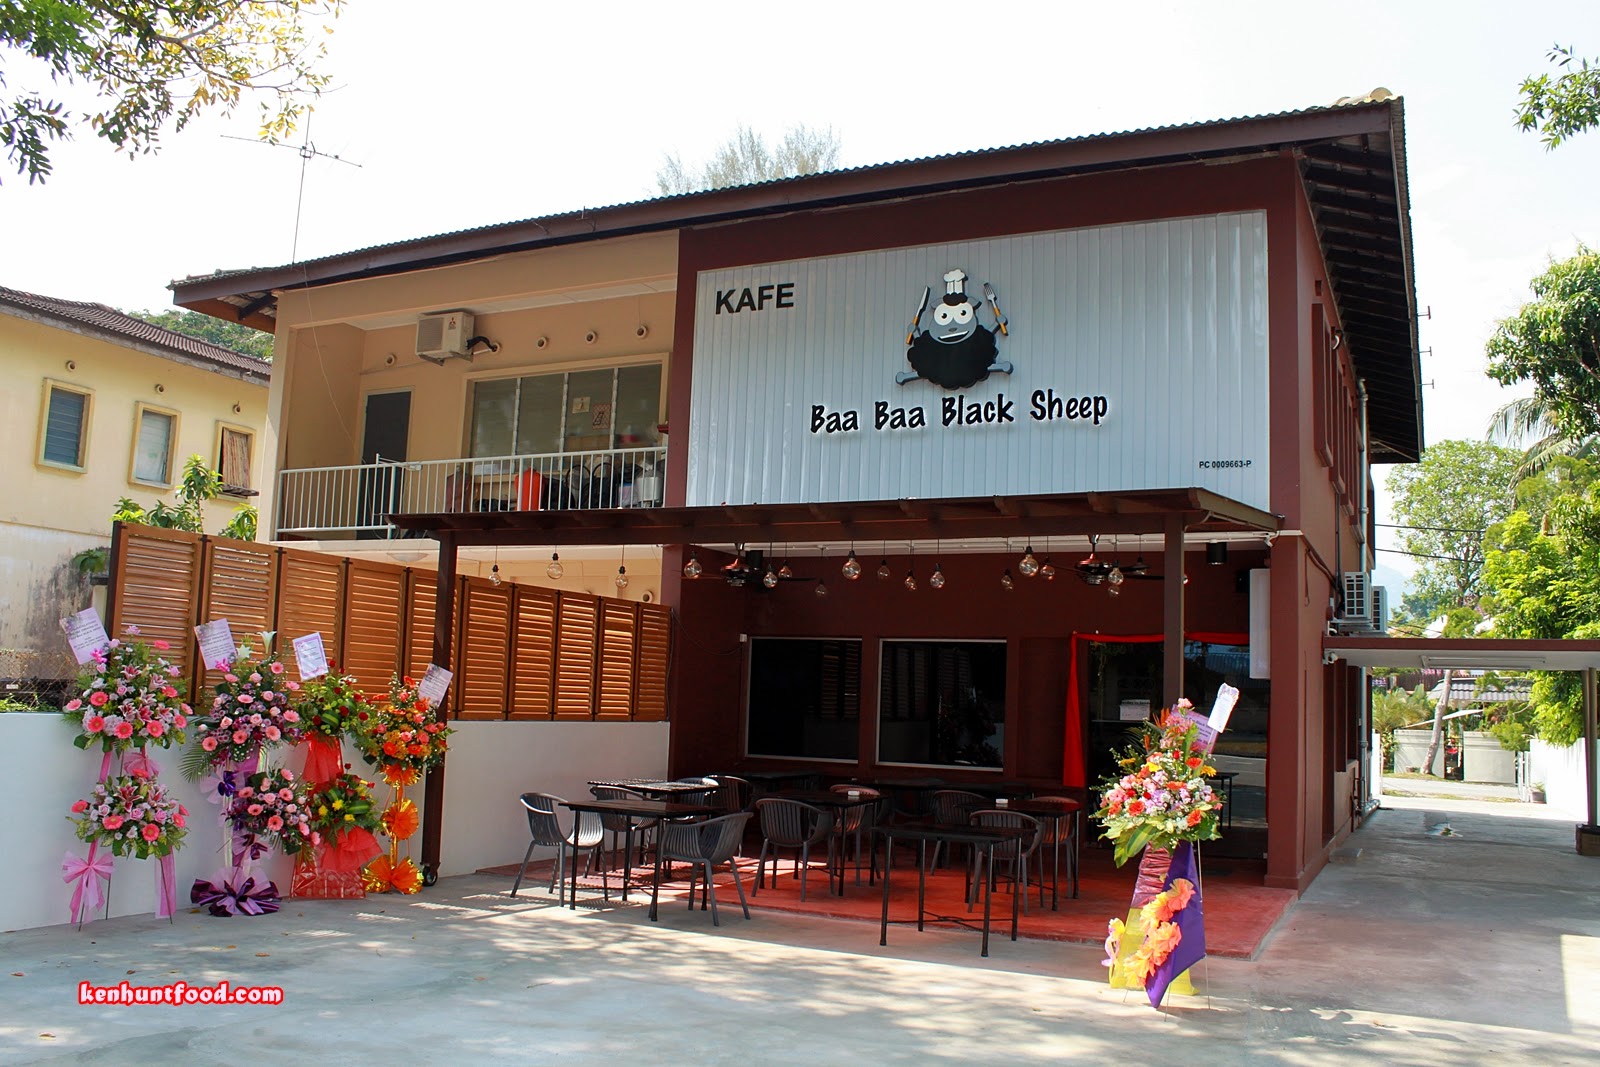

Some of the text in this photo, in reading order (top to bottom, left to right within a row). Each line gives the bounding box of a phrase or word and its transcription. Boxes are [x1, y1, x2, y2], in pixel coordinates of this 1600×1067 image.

[715, 283, 795, 315] KAFE
[810, 388, 1108, 434] Baa Baa Black Sheep
[1198, 460, 1252, 469] PC 0009663-P
